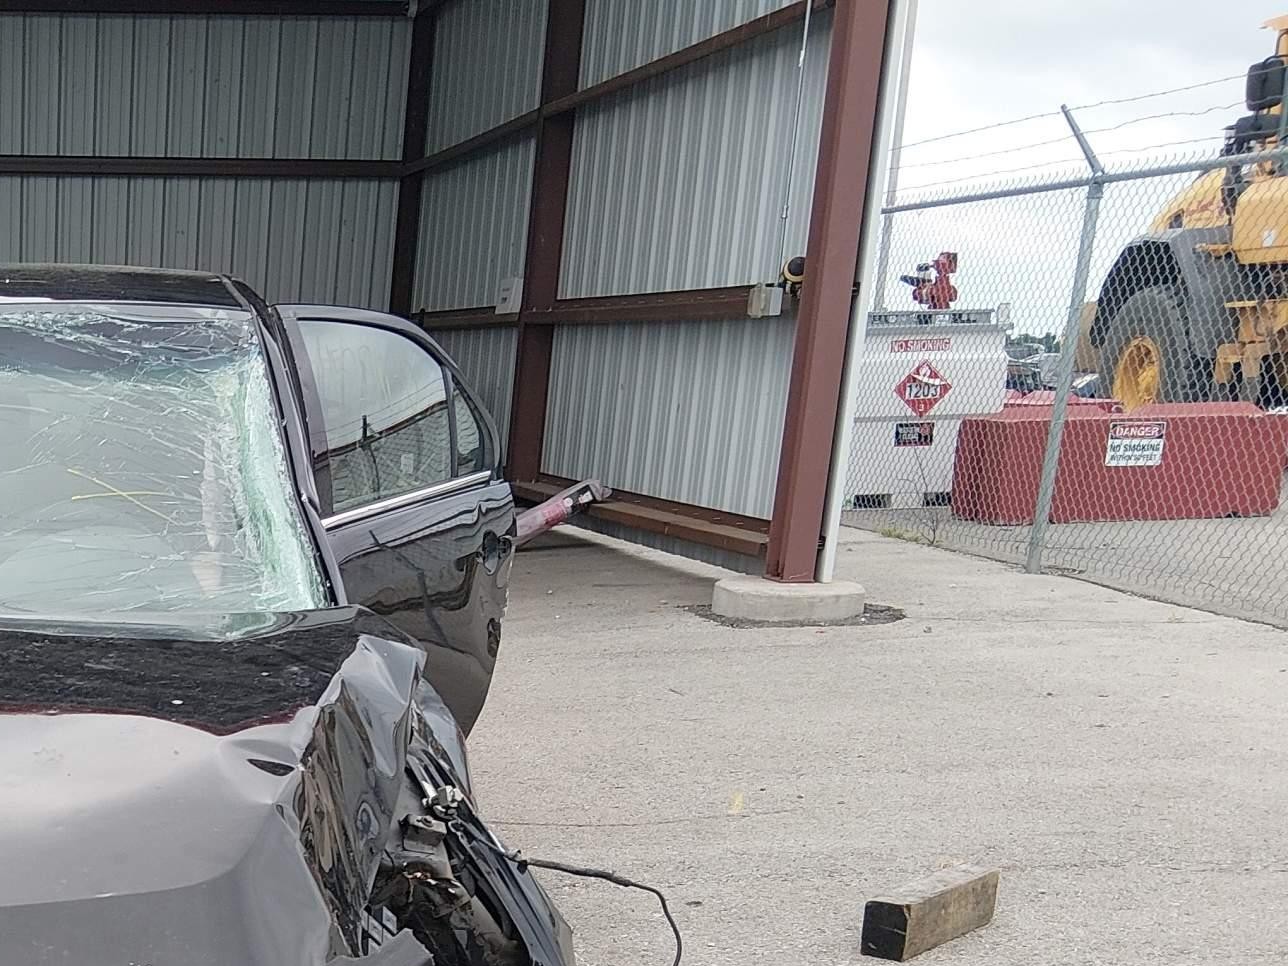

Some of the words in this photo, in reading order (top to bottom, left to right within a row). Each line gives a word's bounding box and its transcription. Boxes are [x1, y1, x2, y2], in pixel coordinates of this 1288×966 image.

[892, 340, 905, 352] NO
[906, 338, 951, 352] SMOKING
[907, 384, 939, 398] 1203
[1115, 426, 1159, 436] DANGER
[1110, 443, 1121, 452] NO
[1123, 443, 1161, 452] SMOKING
